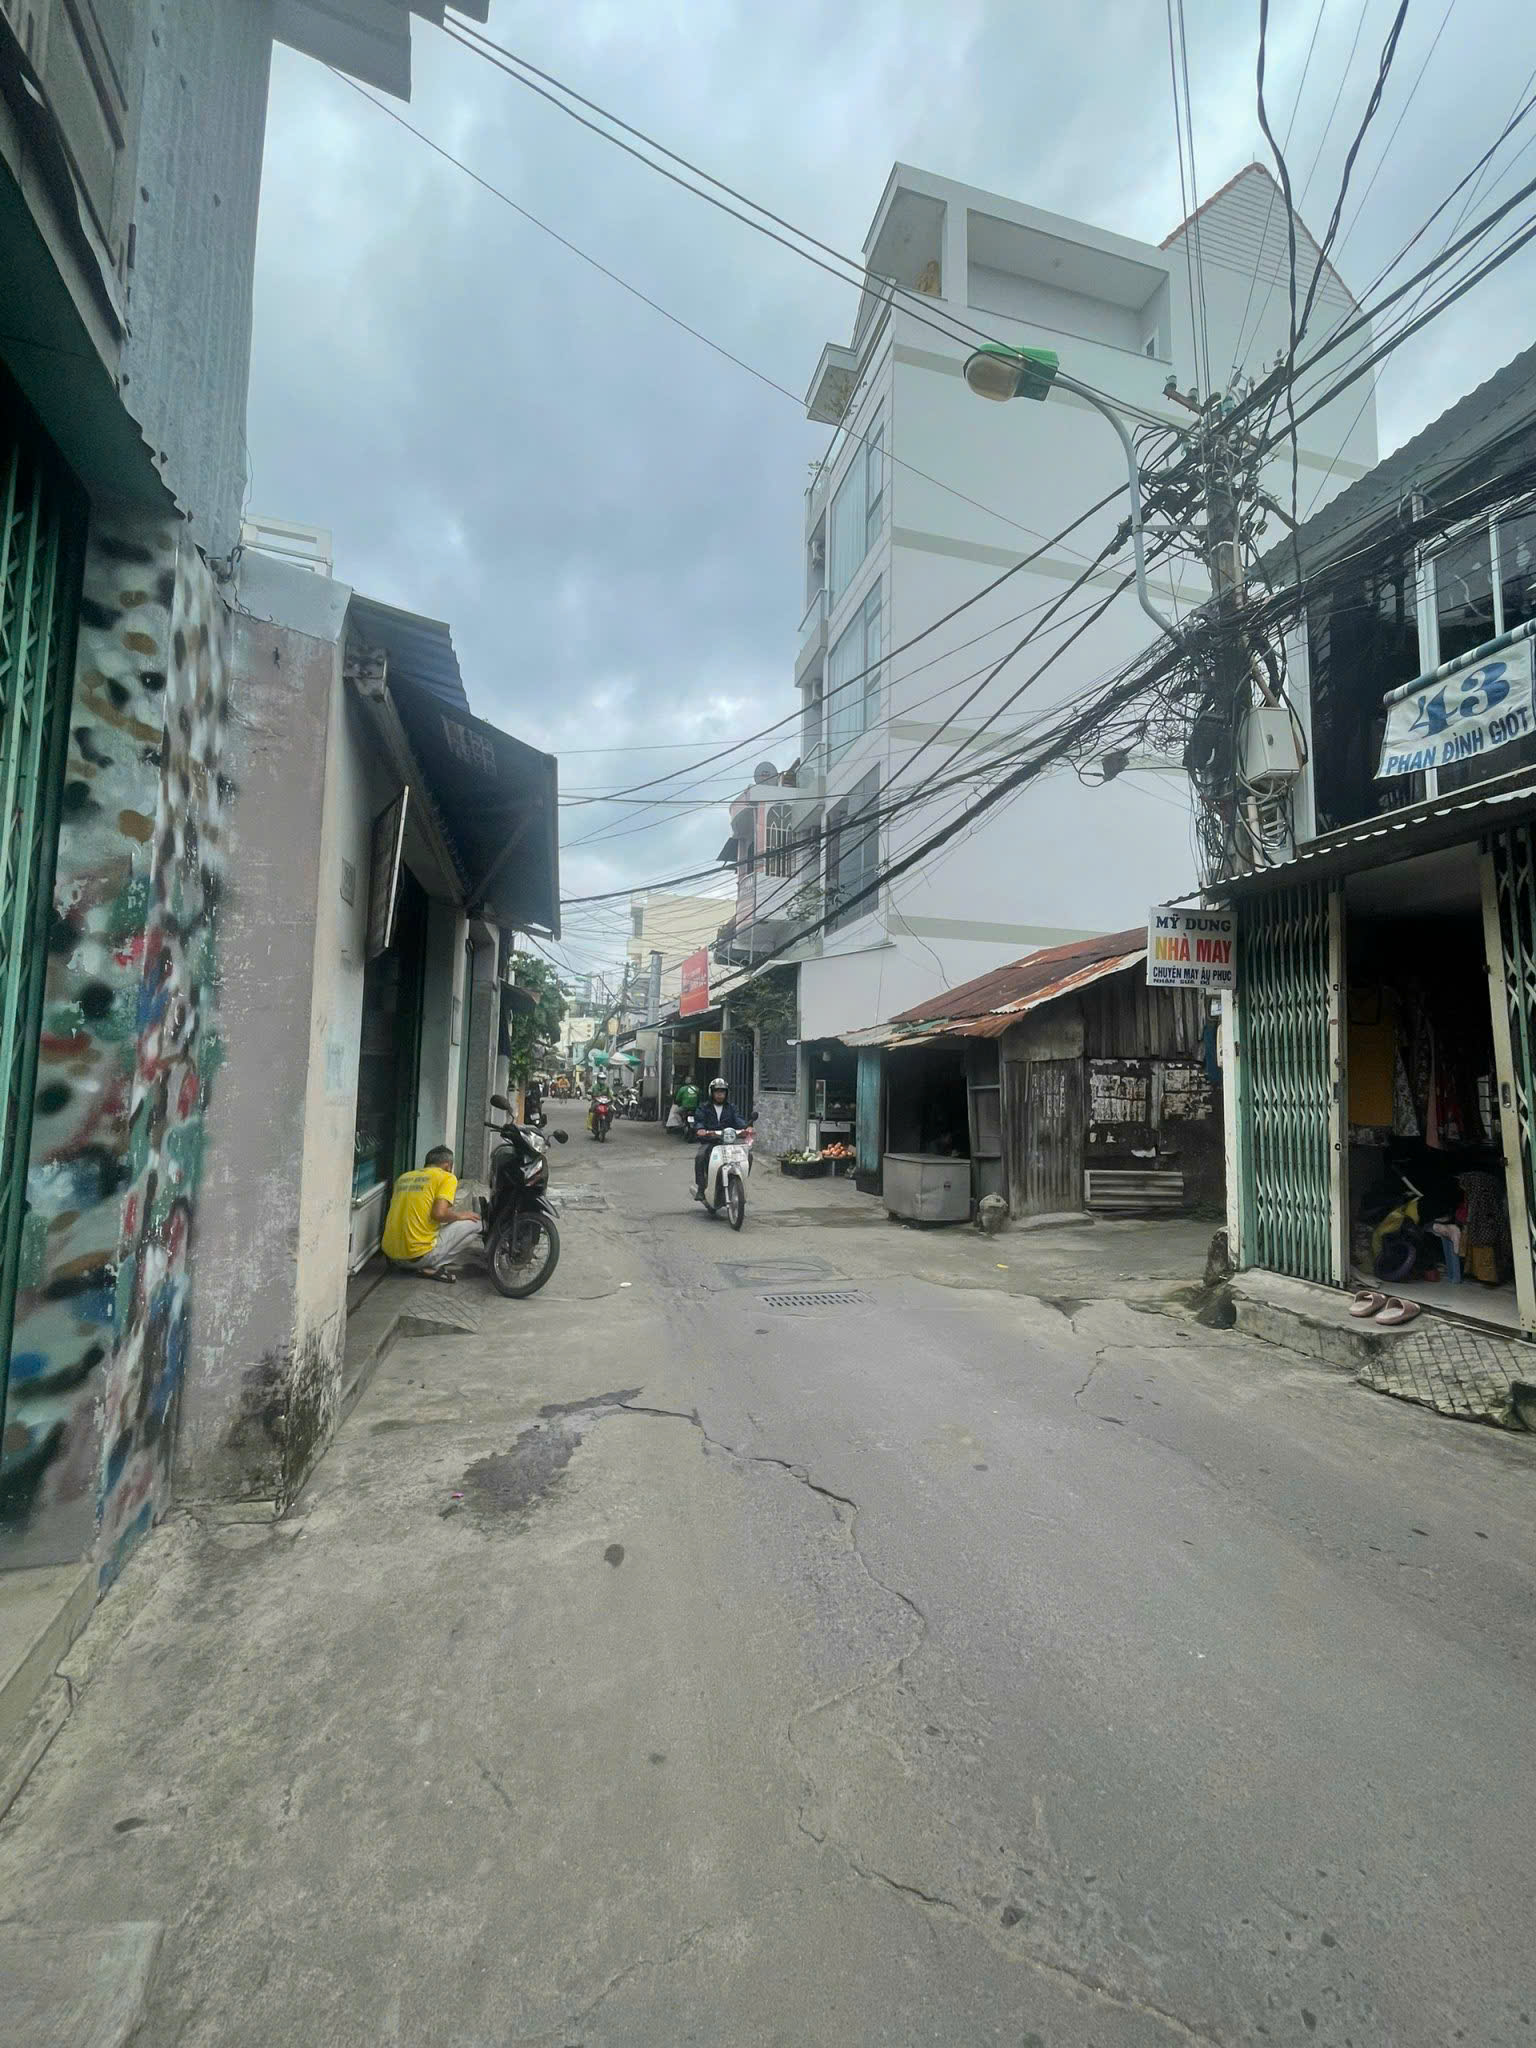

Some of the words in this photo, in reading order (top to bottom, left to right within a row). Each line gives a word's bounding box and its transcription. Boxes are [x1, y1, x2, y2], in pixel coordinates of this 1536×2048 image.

[1408, 662, 1510, 738] 43
[1386, 746, 1436, 774] PHAN
[1441, 727, 1485, 764] ĐÌNH
[1156, 913, 1180, 929] MỸ
[1185, 918, 1231, 932] DUNG
[1155, 933, 1191, 962] NHÀ
[1196, 939, 1232, 964] MAY
[1153, 965, 1181, 979] CHUYÊN
[1183, 968, 1199, 981] MAY
[1212, 970, 1232, 984] PHỤC
